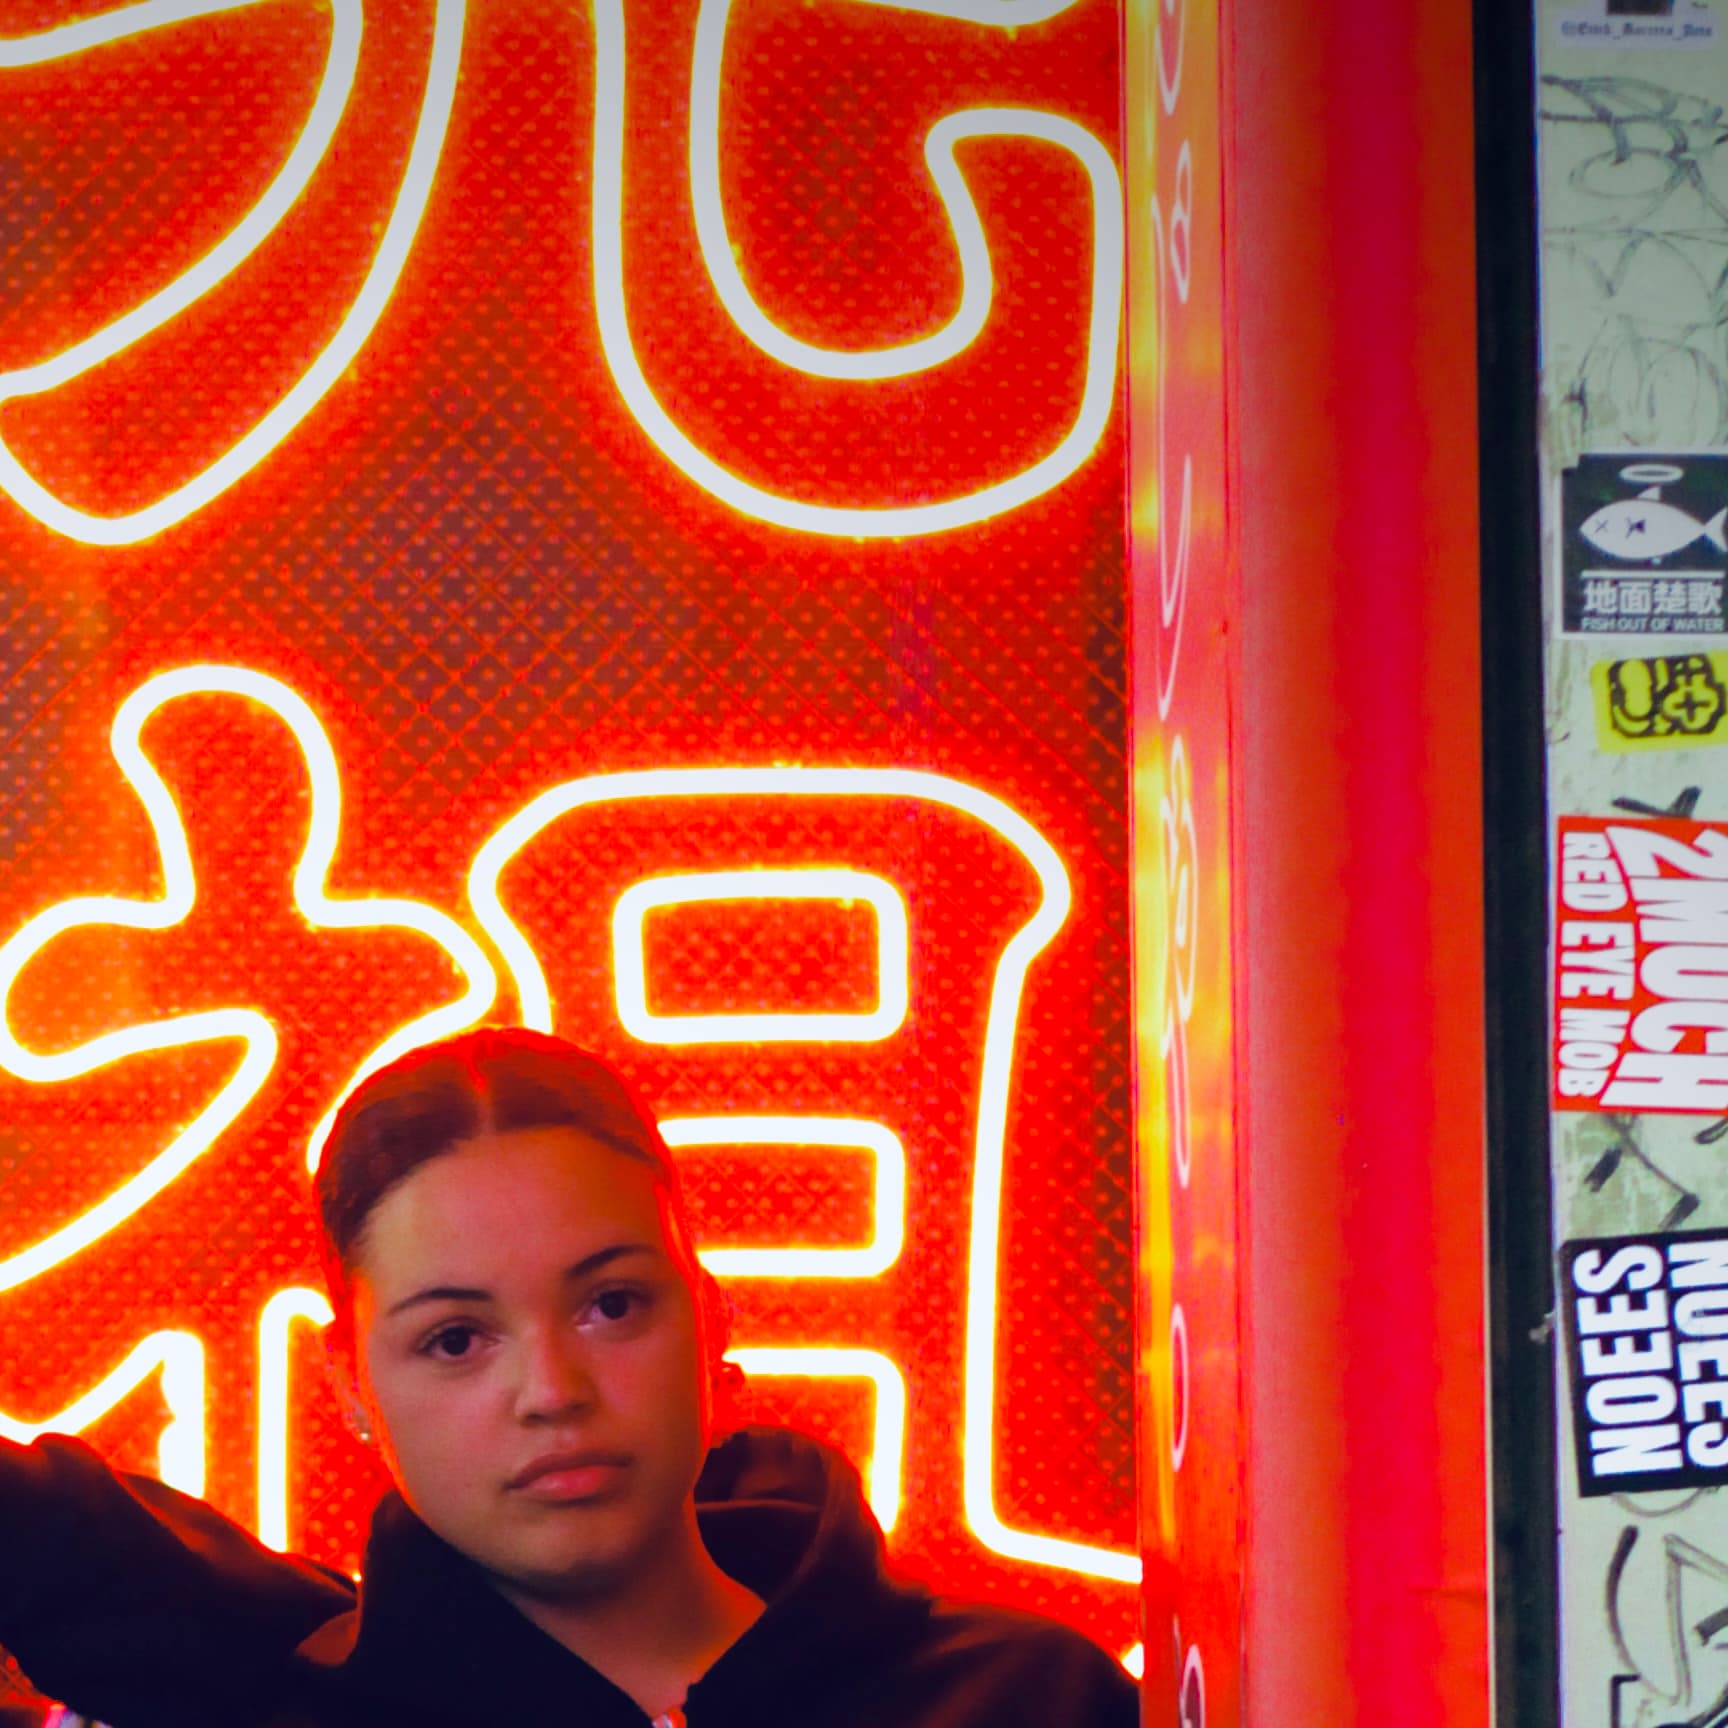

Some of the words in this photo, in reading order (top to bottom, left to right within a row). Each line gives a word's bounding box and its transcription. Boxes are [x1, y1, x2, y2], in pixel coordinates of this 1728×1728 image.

[1581, 617, 1617, 632] FISH
[1618, 617, 1648, 632] OUT
[1650, 617, 1672, 632] OF
[1674, 617, 1725, 632] WATER
[1562, 831, 1629, 912] RED
[1560, 920, 1636, 1000] EYE
[1558, 1007, 1631, 1097] MOB
[1572, 1243, 1684, 1477] NOEES
